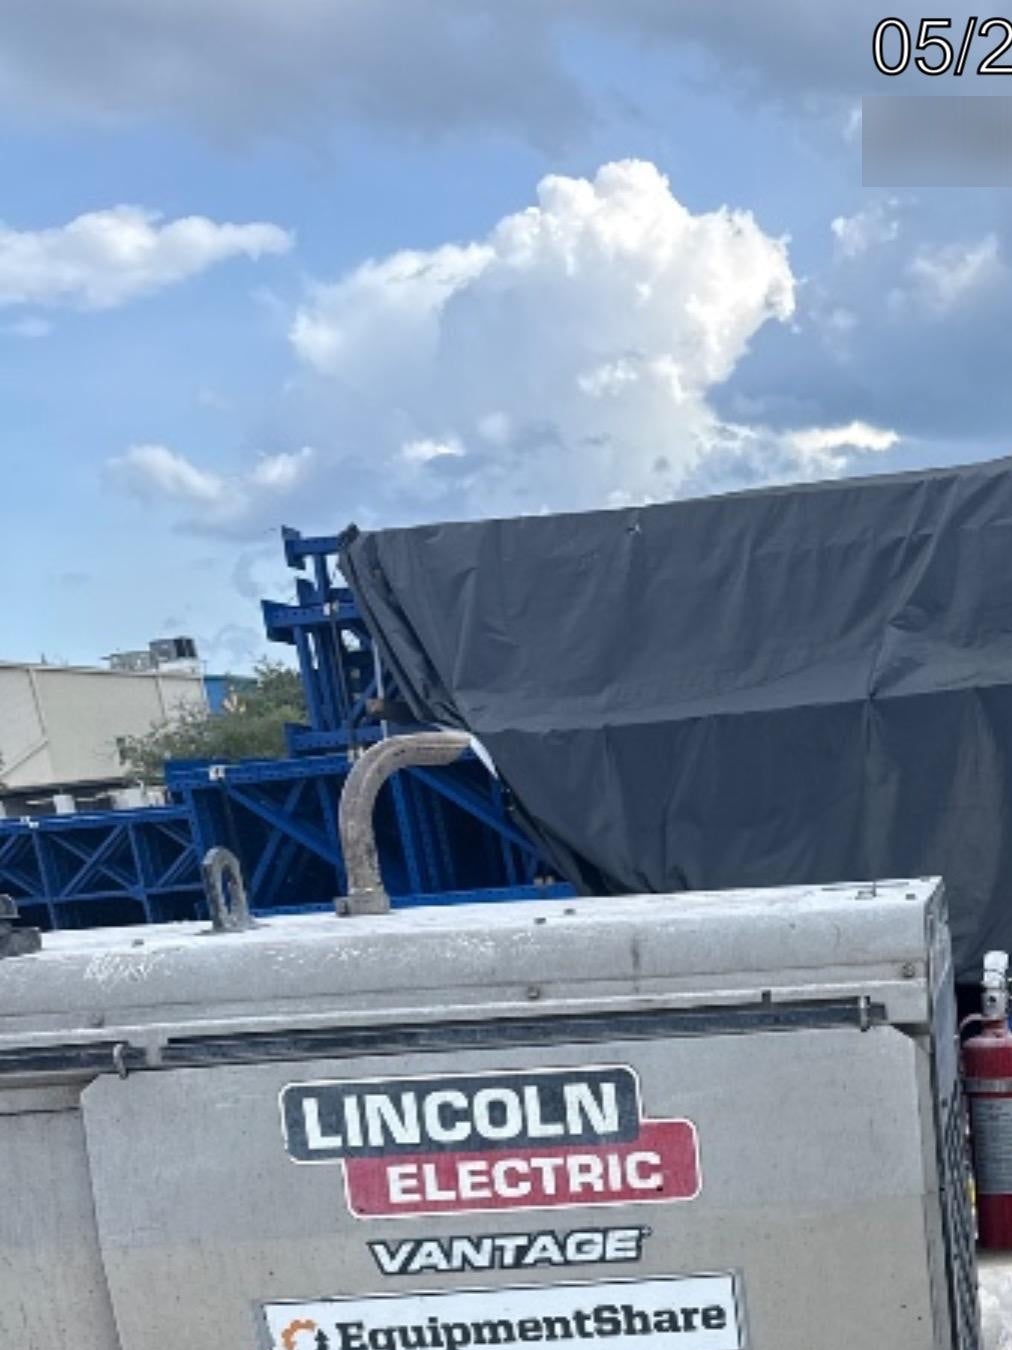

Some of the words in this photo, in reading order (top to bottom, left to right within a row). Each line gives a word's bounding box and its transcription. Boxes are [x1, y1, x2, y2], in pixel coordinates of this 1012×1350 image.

[302, 1082, 620, 1151] LINCOLN
[387, 1151, 664, 1204] ELECTRIC
[371, 1228, 646, 1274] VANTAGE
